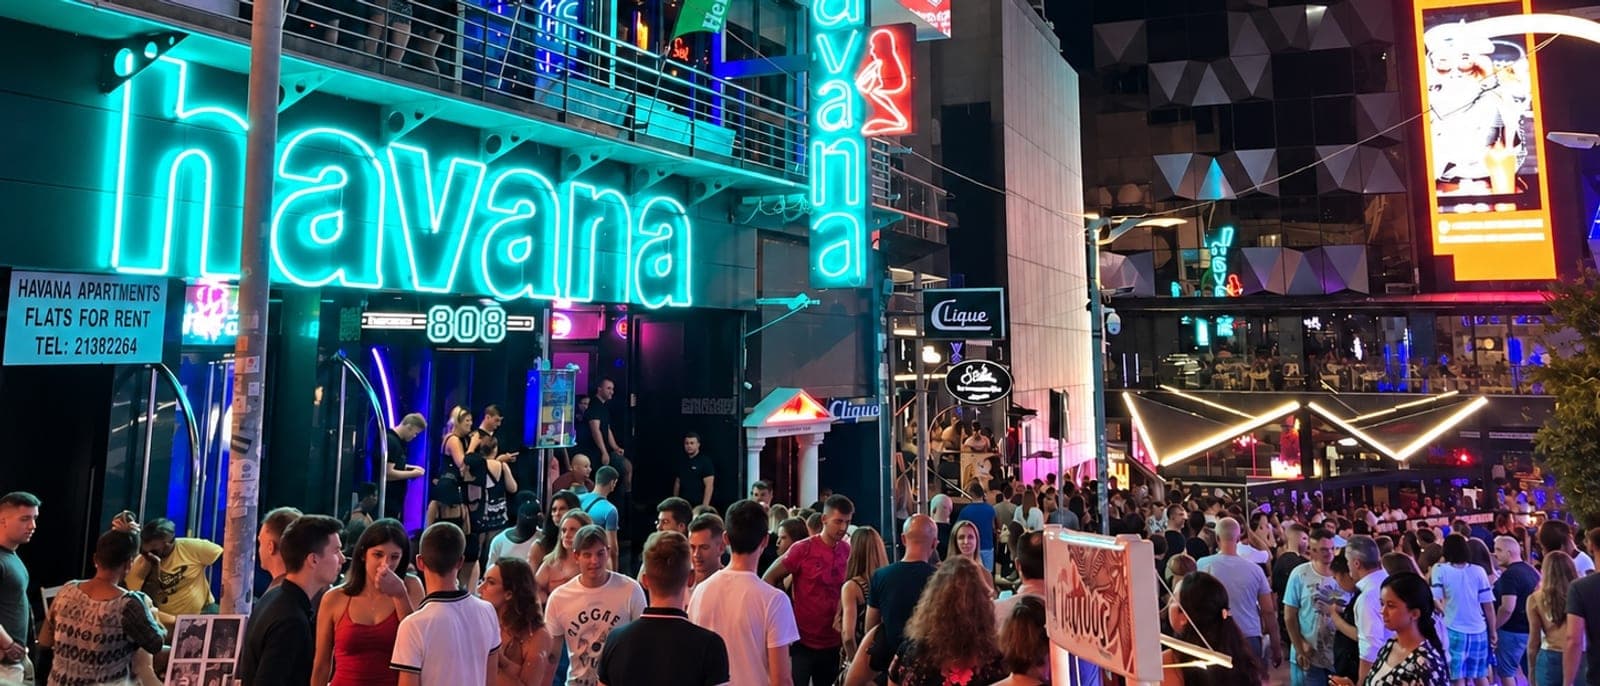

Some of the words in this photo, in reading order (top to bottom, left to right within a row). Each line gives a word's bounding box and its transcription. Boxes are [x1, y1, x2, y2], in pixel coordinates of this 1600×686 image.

[112, 56, 694, 309] havana
[18, 279, 72, 299] HAVANA
[77, 281, 161, 302] APARTMENTS
[25, 307, 73, 327] FLATS
[79, 309, 109, 327] FOR
[114, 310, 151, 328] RENT
[427, 305, 507, 343] 808
[35, 337, 69, 355] TEL:
[75, 337, 138, 355] 21382264
